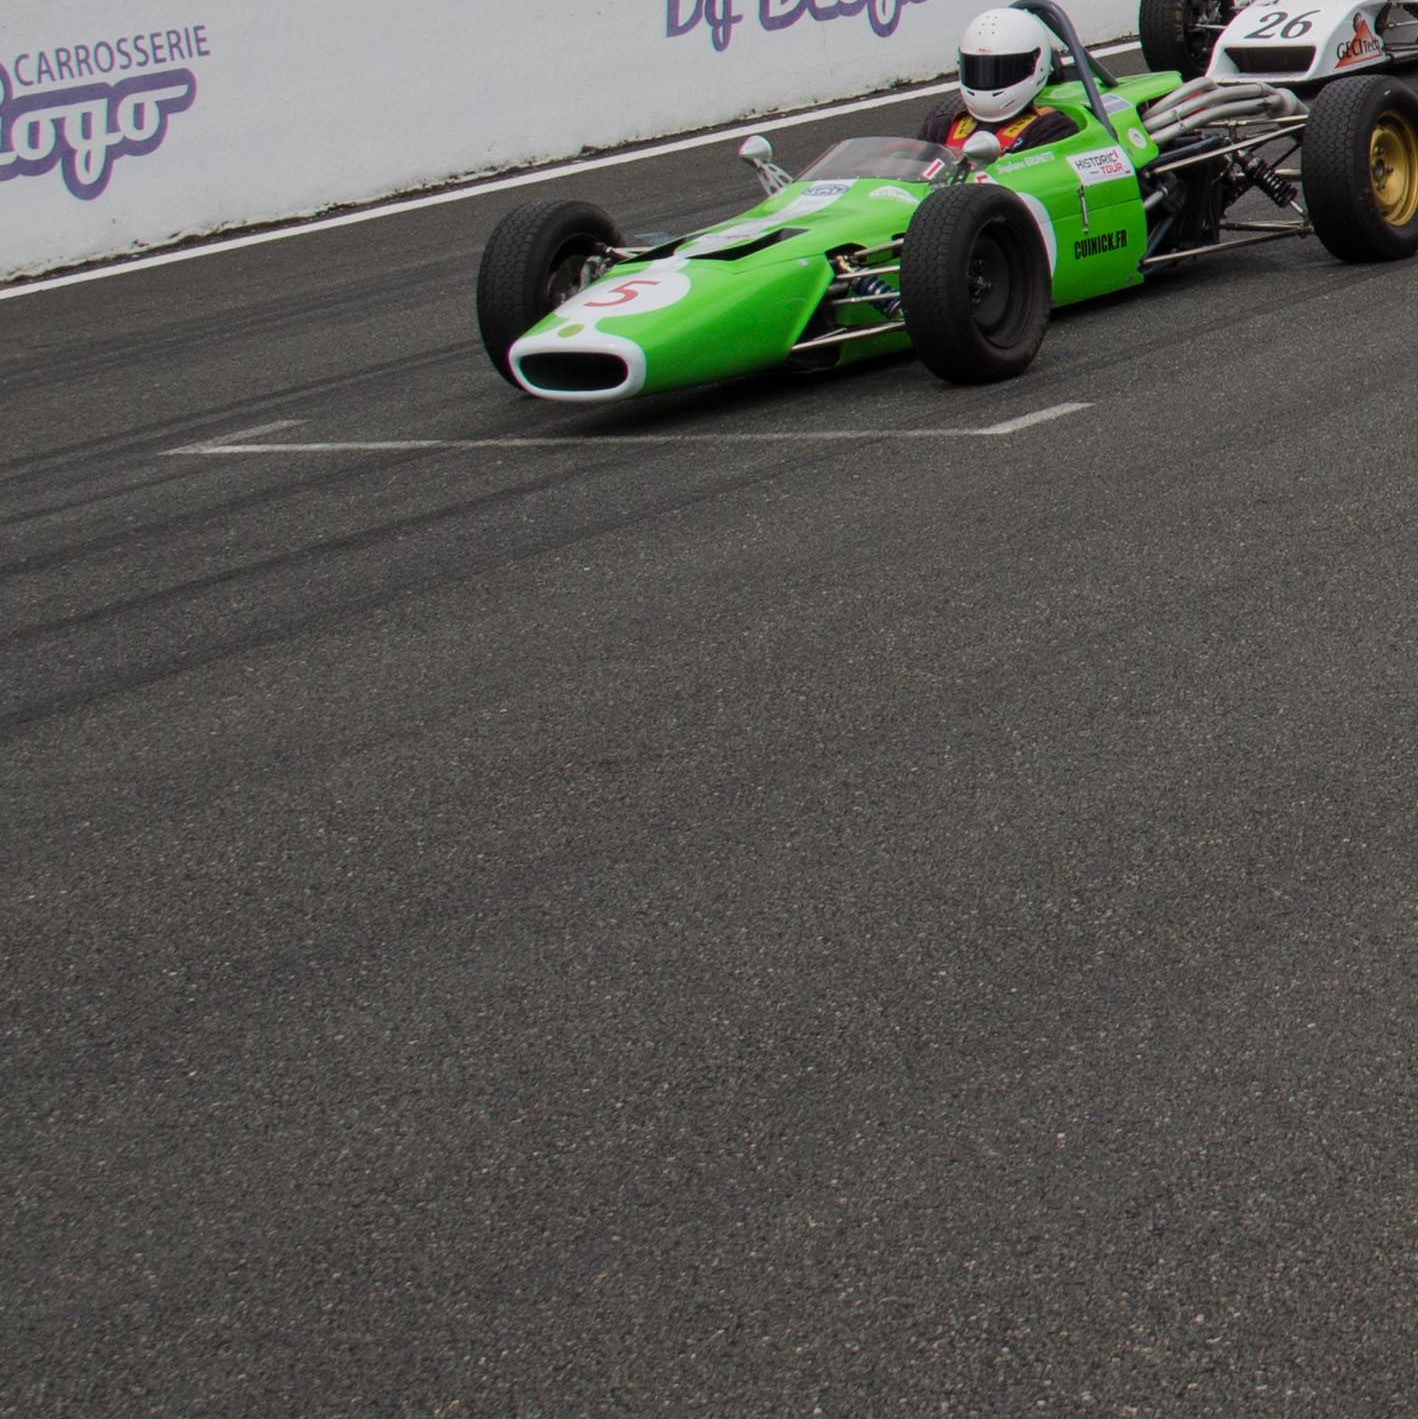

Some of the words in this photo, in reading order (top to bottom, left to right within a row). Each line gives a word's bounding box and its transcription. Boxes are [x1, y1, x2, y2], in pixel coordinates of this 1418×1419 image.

[1244, 9, 1322, 39] 26
[14, 24, 211, 86] CARROSSERIE
[1100, 163, 1124, 175] TOUR
[1074, 229, 1127, 260] CUINICK.FR
[584, 279, 661, 308] 5
